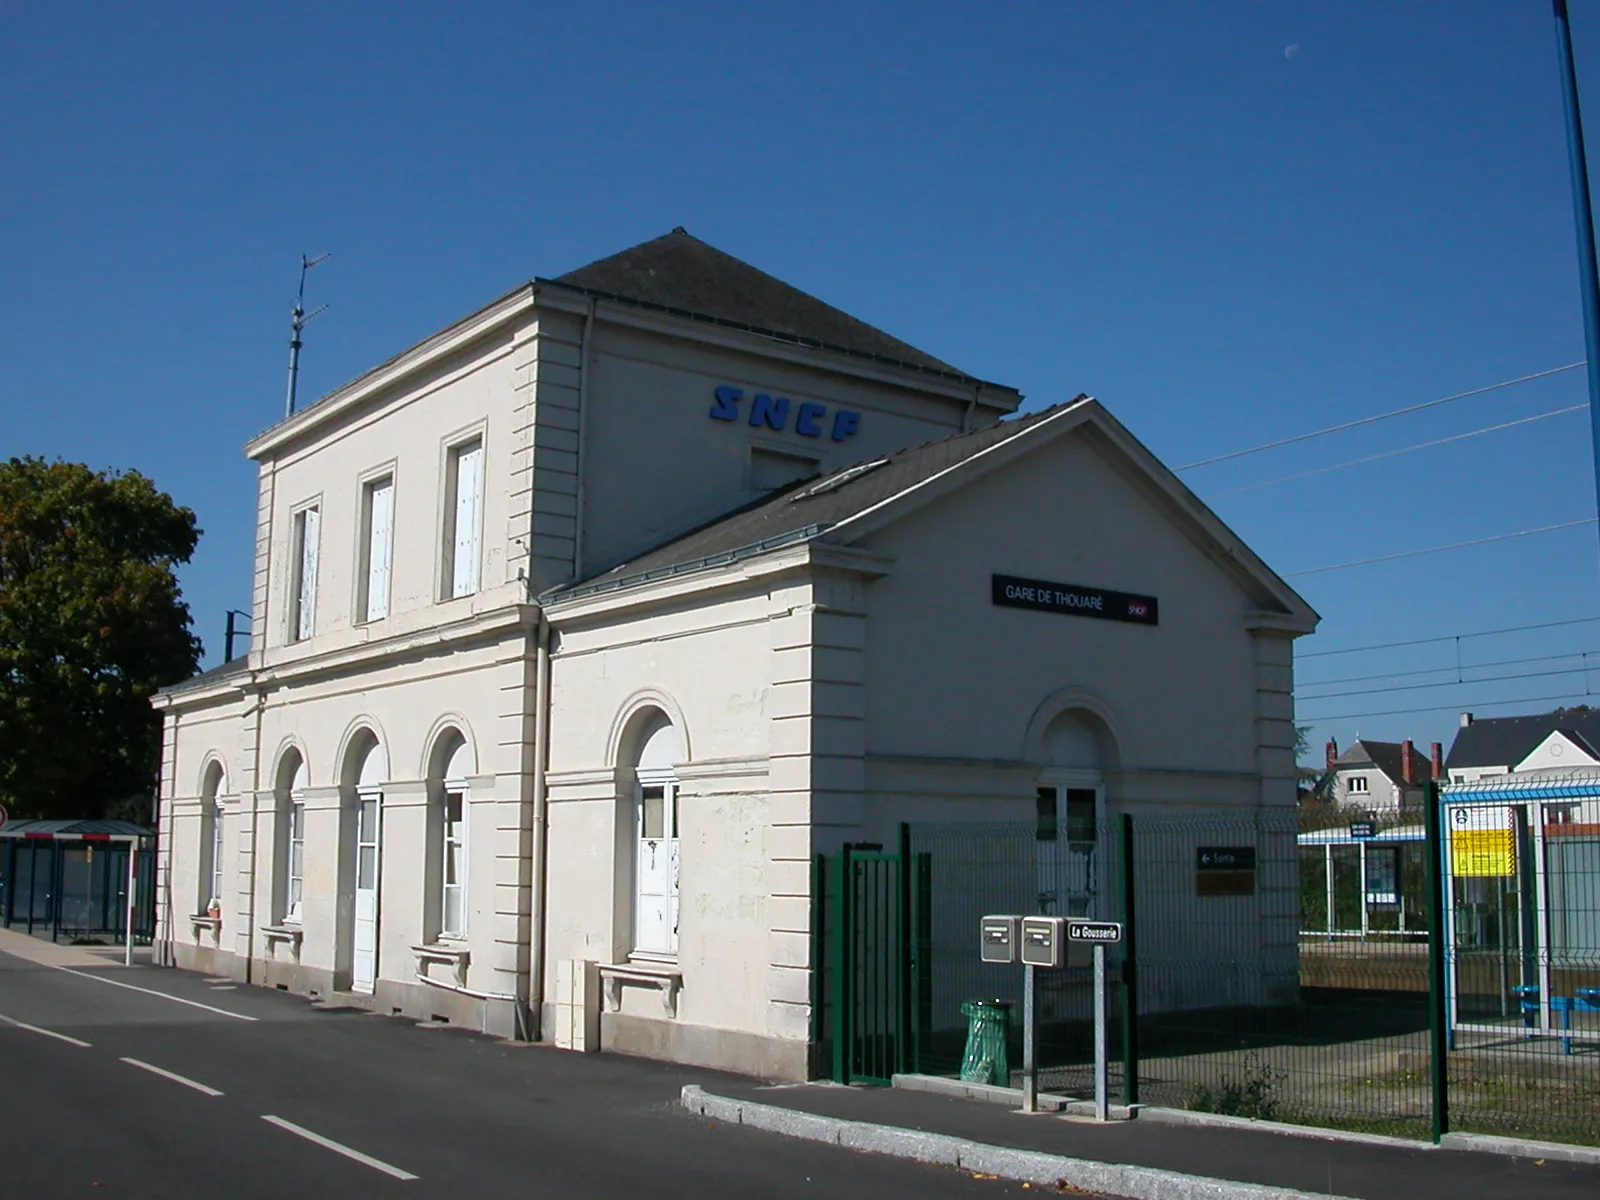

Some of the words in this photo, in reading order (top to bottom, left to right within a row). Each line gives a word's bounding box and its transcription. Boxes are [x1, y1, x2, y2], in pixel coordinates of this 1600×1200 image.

[710, 385, 861, 441] SNCF
[1005, 585, 1035, 601] GARE
[1037, 589, 1051, 604] DE
[1054, 591, 1103, 610] THOUARÉ
[1128, 605, 1147, 616] SNCF
[1071, 926, 1080, 938] La
[1082, 926, 1117, 939] Gousserie
